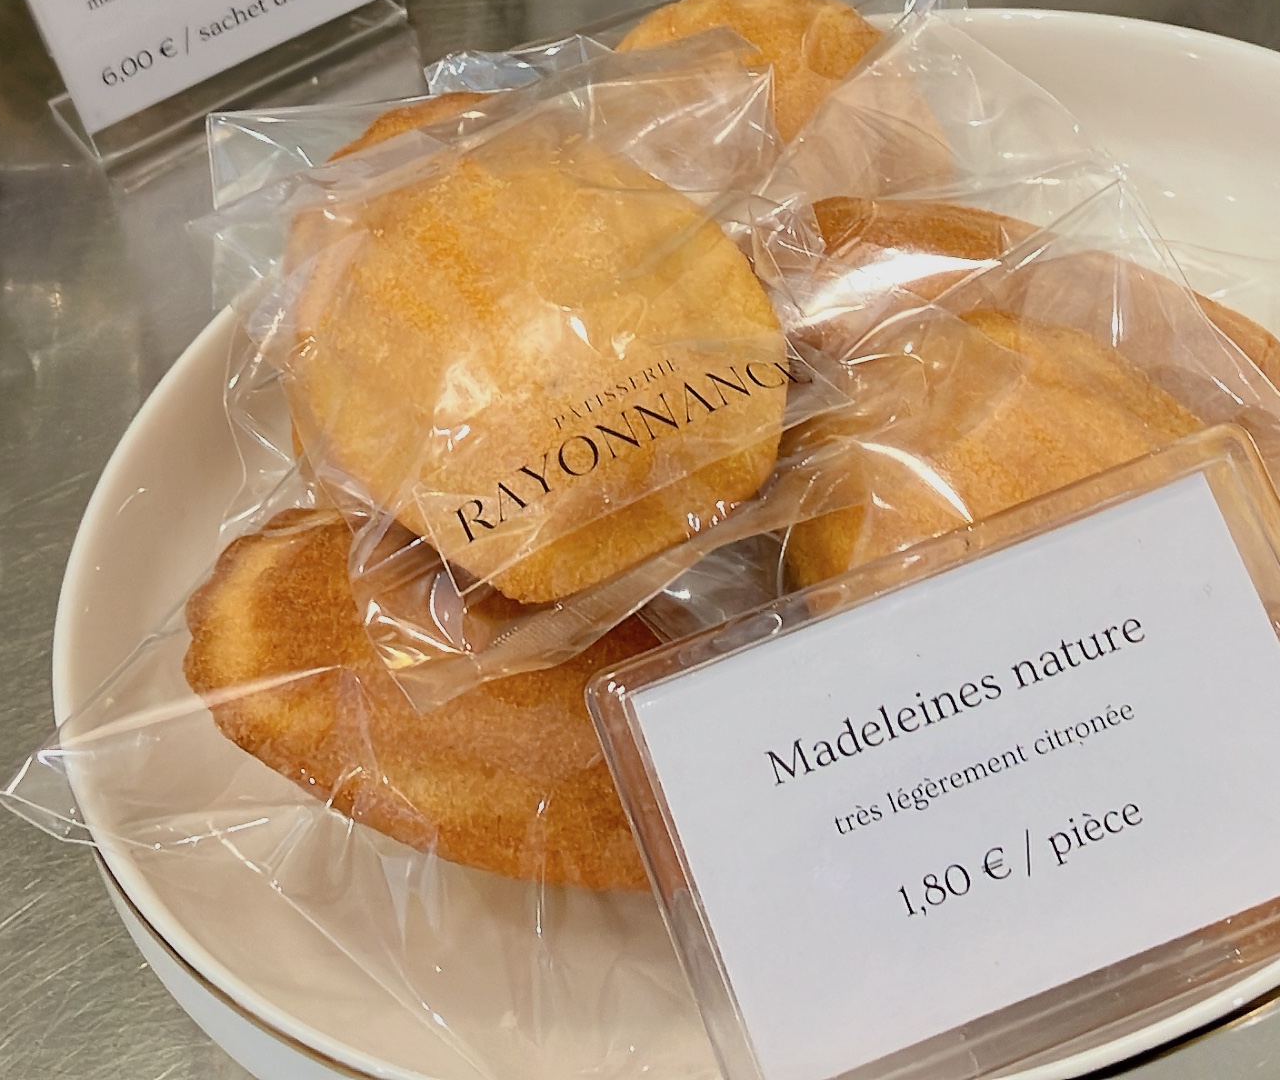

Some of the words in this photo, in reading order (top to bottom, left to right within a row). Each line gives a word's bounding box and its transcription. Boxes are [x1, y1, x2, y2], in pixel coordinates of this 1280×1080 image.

[101, 49, 153, 87] 6,00
[160, 37, 178, 58] €
[184, 26, 190, 55] /
[764, 672, 1003, 787] Madeleines
[1011, 617, 1146, 690] nature
[834, 802, 884, 836] très
[886, 742, 1029, 812] légèrement
[1033, 703, 1136, 757] citronée
[898, 864, 972, 918] 1,80
[981, 846, 1013, 881] €
[1025, 828, 1032, 877] /
[1047, 802, 1144, 866] pièce
